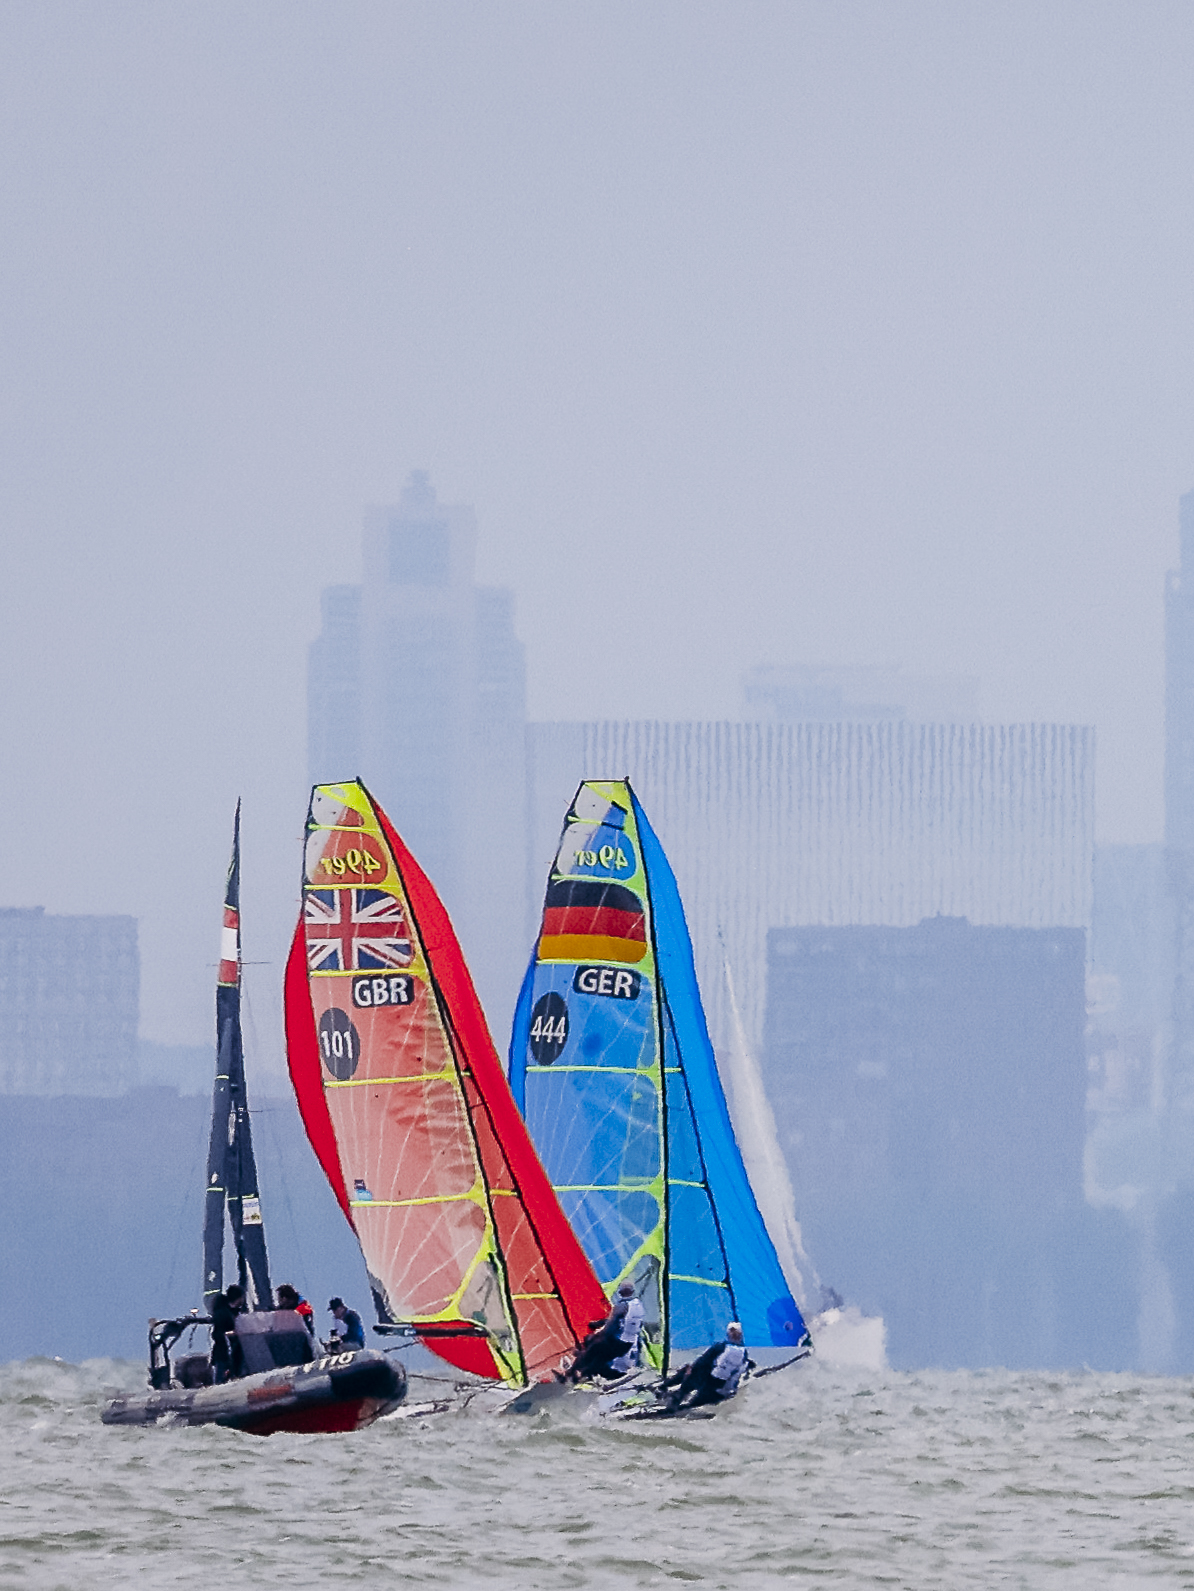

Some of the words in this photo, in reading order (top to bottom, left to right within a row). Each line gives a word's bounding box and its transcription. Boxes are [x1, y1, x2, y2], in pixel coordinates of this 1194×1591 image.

[354, 977, 409, 1007] GBR
[577, 968, 634, 998] GER
[530, 1015, 566, 1044] 444
[321, 1030, 353, 1060] 101
